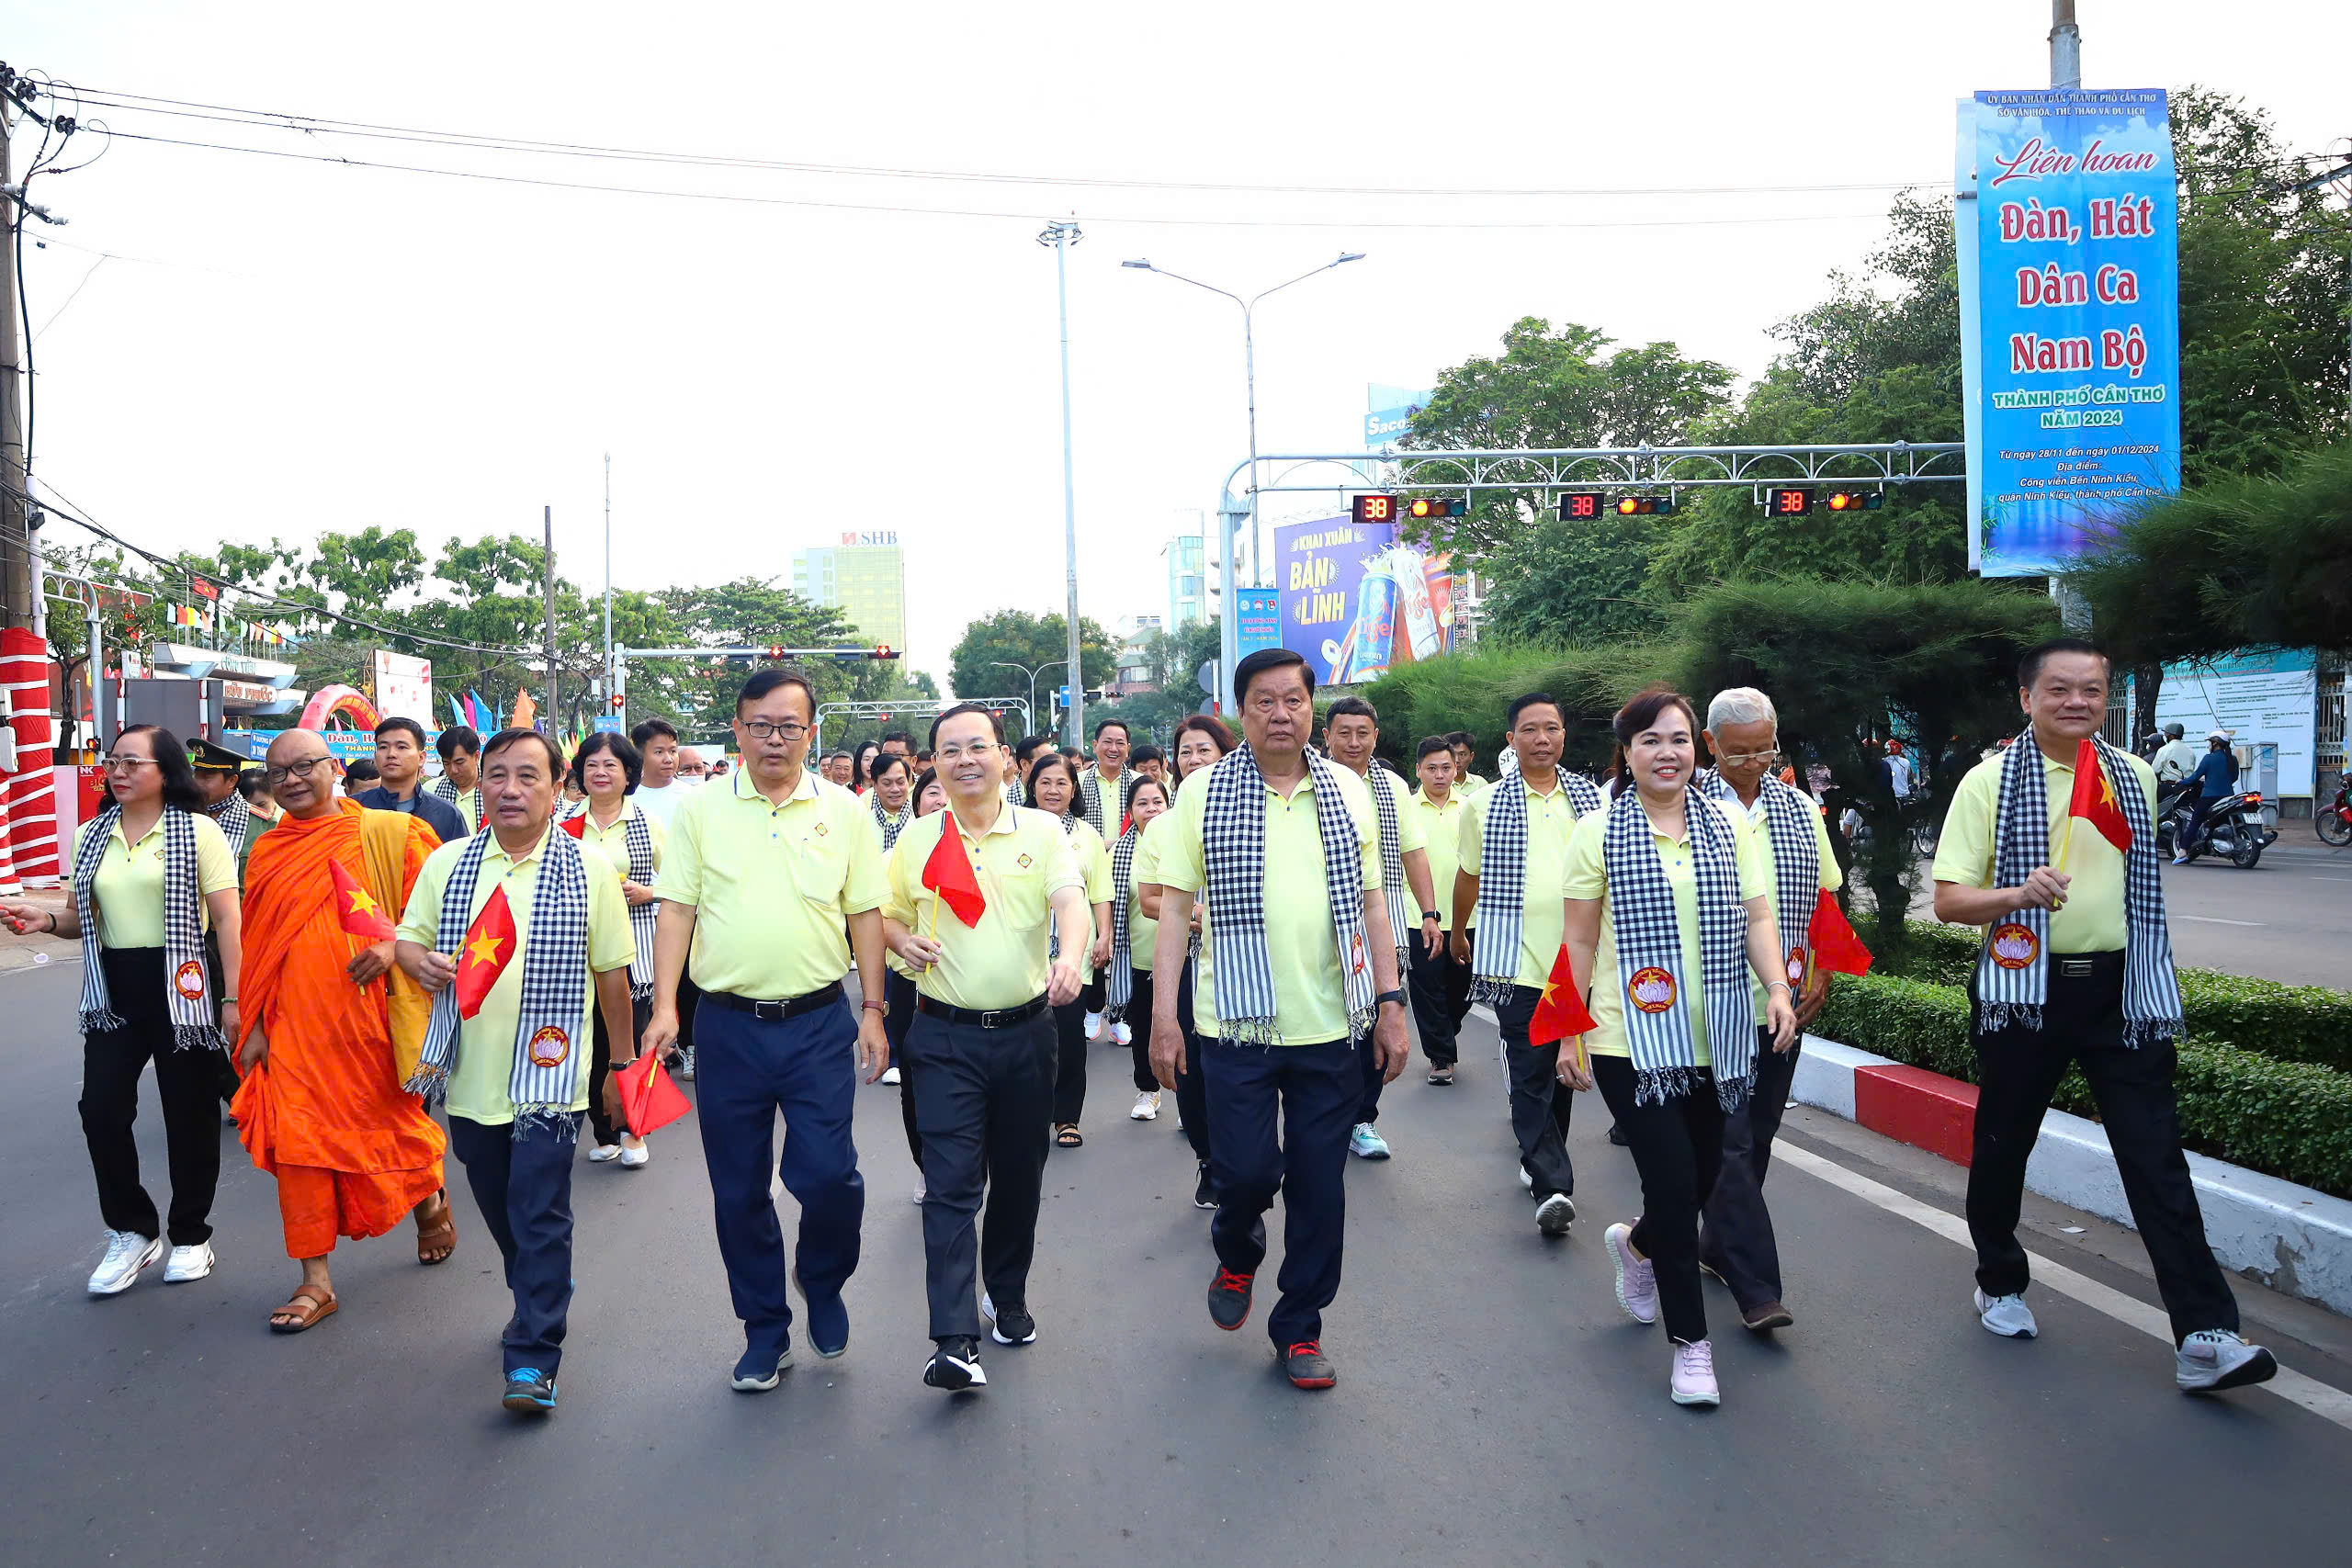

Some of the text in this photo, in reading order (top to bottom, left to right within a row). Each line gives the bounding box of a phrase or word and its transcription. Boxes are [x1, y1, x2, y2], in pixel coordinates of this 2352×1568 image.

[2001, 94, 2018, 103] BAN
[2020, 93, 2045, 103] NHÂN
[2048, 93, 2066, 103] DÂN
[2099, 91, 2118, 103] PHỐ
[2120, 90, 2137, 103] CẦN
[2139, 93, 2157, 103] THƠ
[2074, 107, 2097, 116] THAO
[2098, 105, 2110, 116] VÀ
[2112, 107, 2125, 116] DU
[2126, 107, 2146, 118] LỊCH
[1992, 138, 2159, 187] Liên hoan
[2001, 194, 2153, 243] Đàn, Hát
[2018, 263, 2137, 305] Dân Ca
[2011, 326, 2145, 377] Nam Bộ
[1995, 383, 2165, 407] THÀNH PHỐ CẦN THƠ
[1367, 416, 1410, 436] Saco
[2042, 410, 2121, 427] NĂM 2024
[1999, 445, 2159, 461] Từ ngày 28/11 đến ngày 01/12/2024
[2057, 462, 2073, 473] Địa
[2019, 477, 2044, 489] Công
[2047, 476, 2067, 486] viên
[2070, 474, 2088, 485] Bến
[2090, 475, 2113, 484] Ninh
[1781, 491, 1803, 512] 38
[2024, 491, 2046, 501] Ninh
[2075, 489, 2101, 499] thành
[2104, 487, 2124, 500] phố
[1365, 498, 1387, 518] 38
[1572, 496, 1593, 515] 38
[861, 531, 898, 545] SHB
[1298, 526, 1352, 551] KHAI XUÂN
[1289, 550, 1329, 592] BẢN
[1301, 587, 1346, 626] LĨNH
[79, 766, 94, 774] NK
